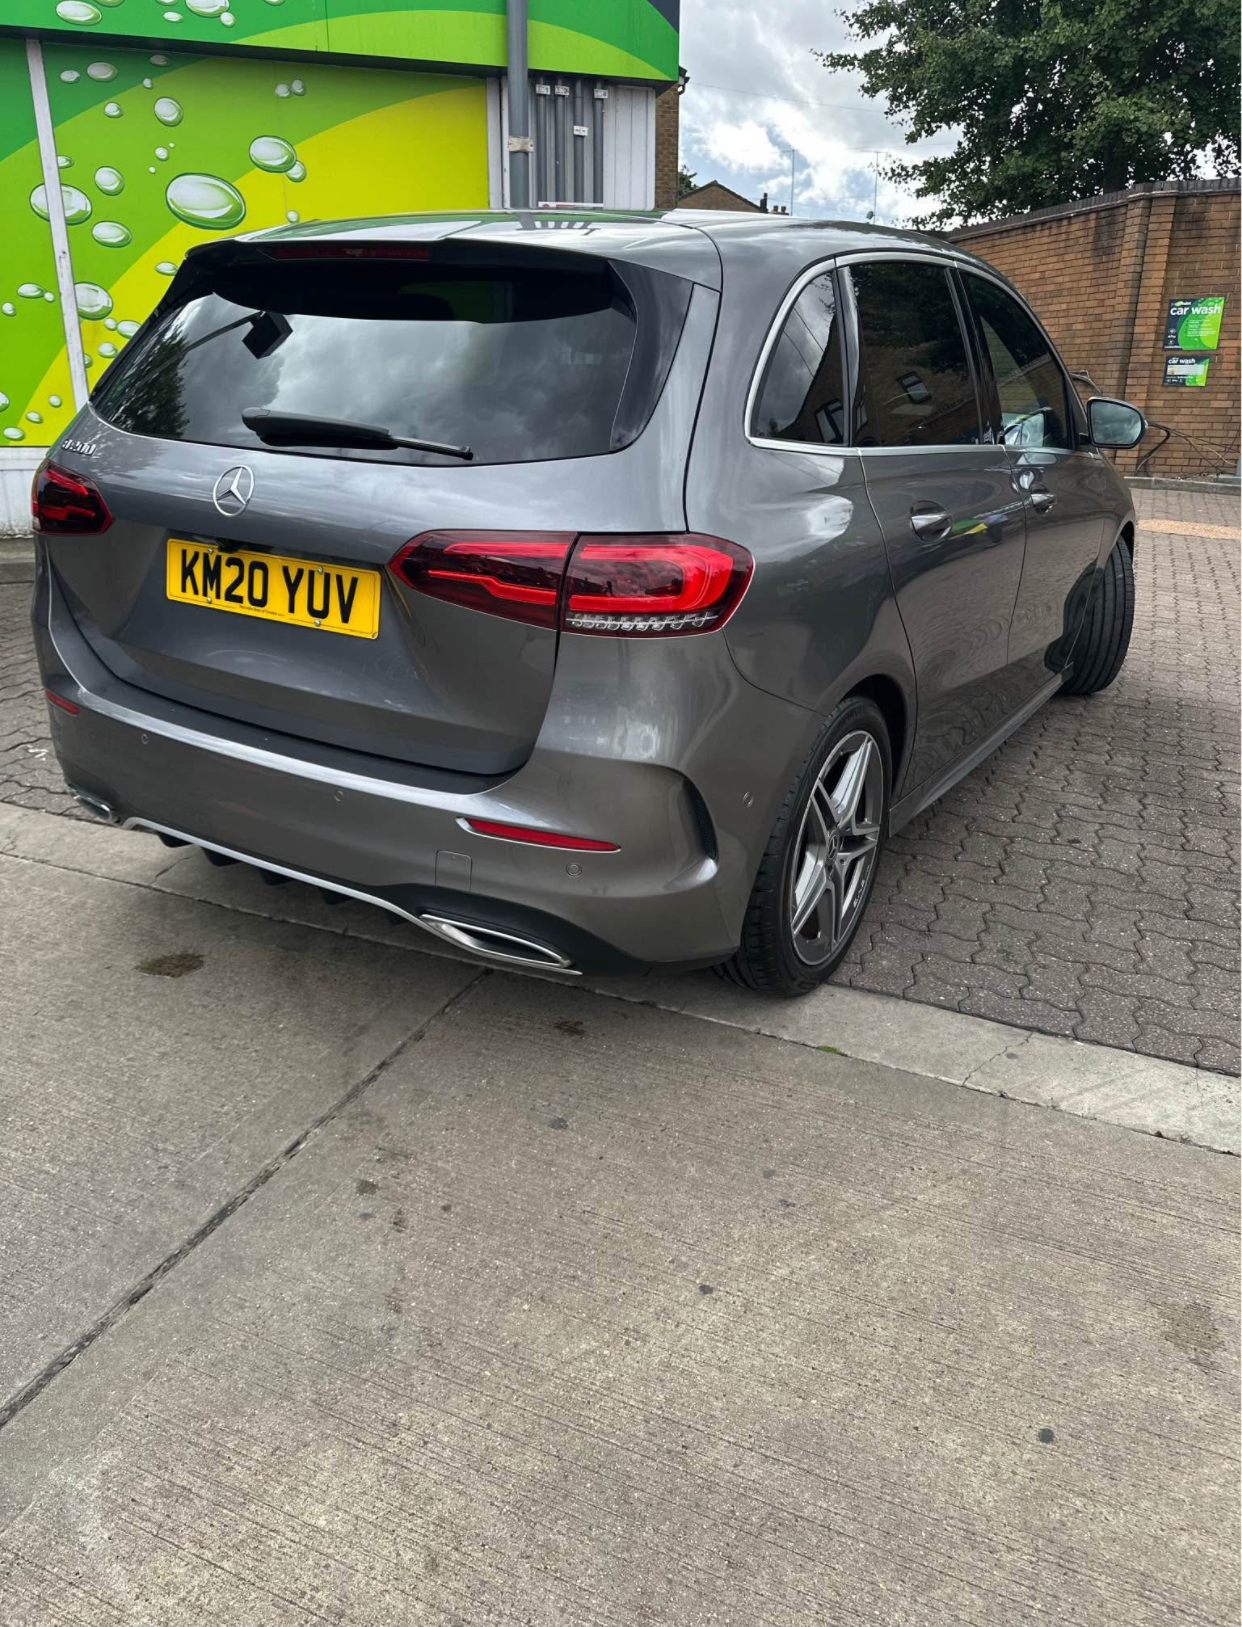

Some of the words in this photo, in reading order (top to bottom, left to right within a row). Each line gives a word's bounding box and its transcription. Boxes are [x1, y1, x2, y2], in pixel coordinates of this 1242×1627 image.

[1170, 306, 1190, 316] car
[1191, 303, 1222, 315] wash
[180, 548, 269, 608] KM20
[282, 565, 359, 624] YUV
